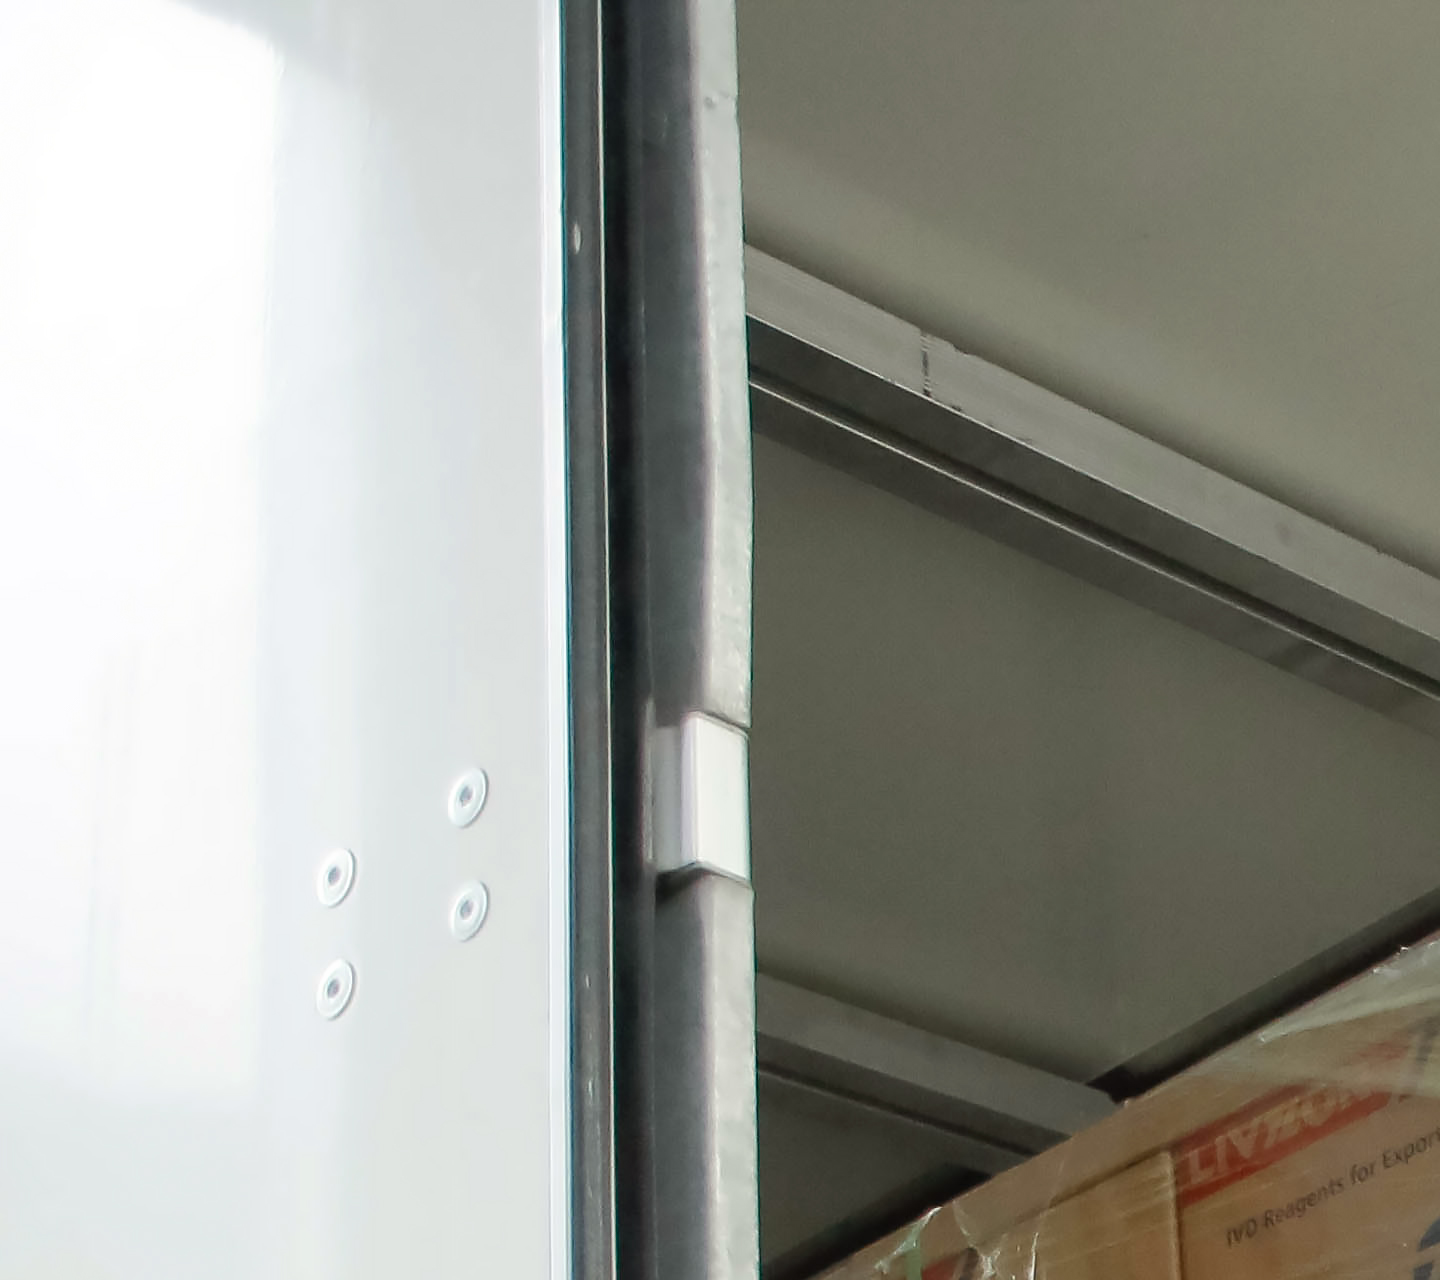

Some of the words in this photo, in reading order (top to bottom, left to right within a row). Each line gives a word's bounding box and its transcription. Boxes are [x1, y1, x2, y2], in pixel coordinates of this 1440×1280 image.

[1226, 1221, 1257, 1248] IVD
[1264, 1173, 1345, 1230] Reagents
[1351, 1158, 1376, 1186] for
